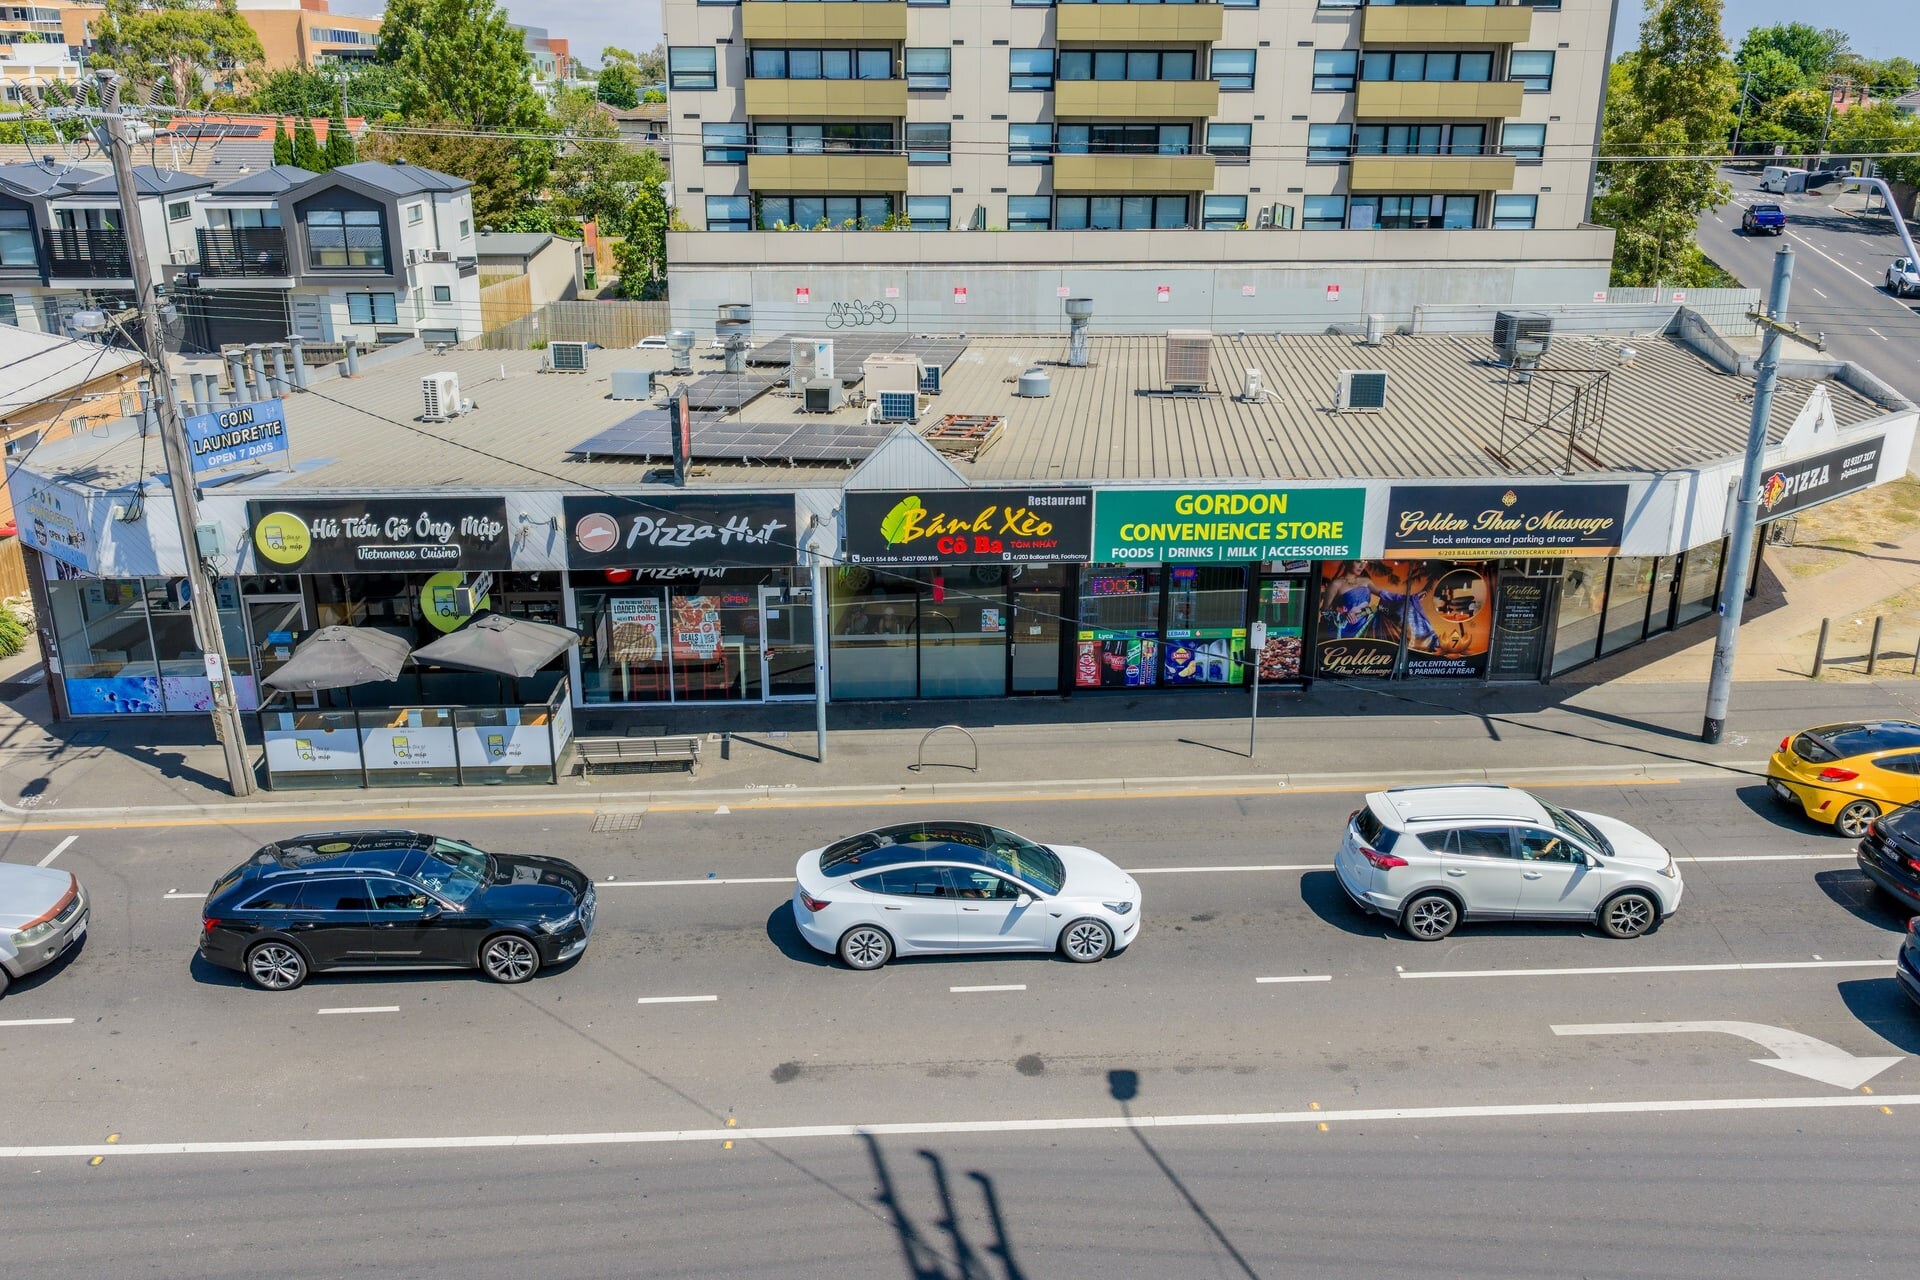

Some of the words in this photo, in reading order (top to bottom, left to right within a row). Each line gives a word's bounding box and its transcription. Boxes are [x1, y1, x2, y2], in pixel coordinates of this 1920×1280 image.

[219, 408, 254, 429] COIN
[194, 420, 282, 455] LAUNDRETTE
[208, 451, 236, 466] OPEN
[240, 450, 245, 458] 7
[249, 442, 273, 456] DAYS
[1784, 464, 1830, 498] PIZZA
[1028, 495, 1087, 506] Restaurant
[1175, 493, 1288, 516] GORDON
[311, 518, 340, 539] Hủ
[415, 511, 455, 544] Ông
[460, 515, 503, 541] Mập
[627, 515, 716, 550] Pizza
[718, 515, 787, 546] Hut
[901, 505, 997, 545] Bánh
[999, 506, 1053, 536] Xèo
[1120, 521, 1272, 541] CONVENIENCE
[1275, 521, 1344, 540] STORE
[1395, 510, 1470, 538] Golden
[1472, 509, 1526, 531] Thai
[1525, 509, 1614, 535] Massage
[937, 535, 968, 555] Cô
[974, 535, 1003, 554] Ba
[1432, 534, 1453, 545] back
[1455, 535, 1492, 545] entrance
[1493, 534, 1511, 544] and
[1512, 534, 1545, 546] parking
[1546, 535, 1556, 543] at
[1557, 535, 1576, 543] rear
[357, 548, 417, 560] Vietnamese
[420, 546, 458, 560] Cuisine
[1012, 553, 1029, 561] 4/203
[1060, 552, 1088, 561] Footscray
[1111, 547, 1154, 559] FOODS
[1168, 547, 1214, 558] DRINKS
[1227, 546, 1257, 557] MILK
[1268, 545, 1349, 556] ACCESSORIES
[1093, 578, 1138, 593] FOOD
[1505, 584, 1541, 597] Golden
[613, 604, 636, 614] LOADED
[637, 604, 658, 613] COOKIE
[680, 633, 699, 641] DEALS
[1321, 646, 1393, 671] Golden
